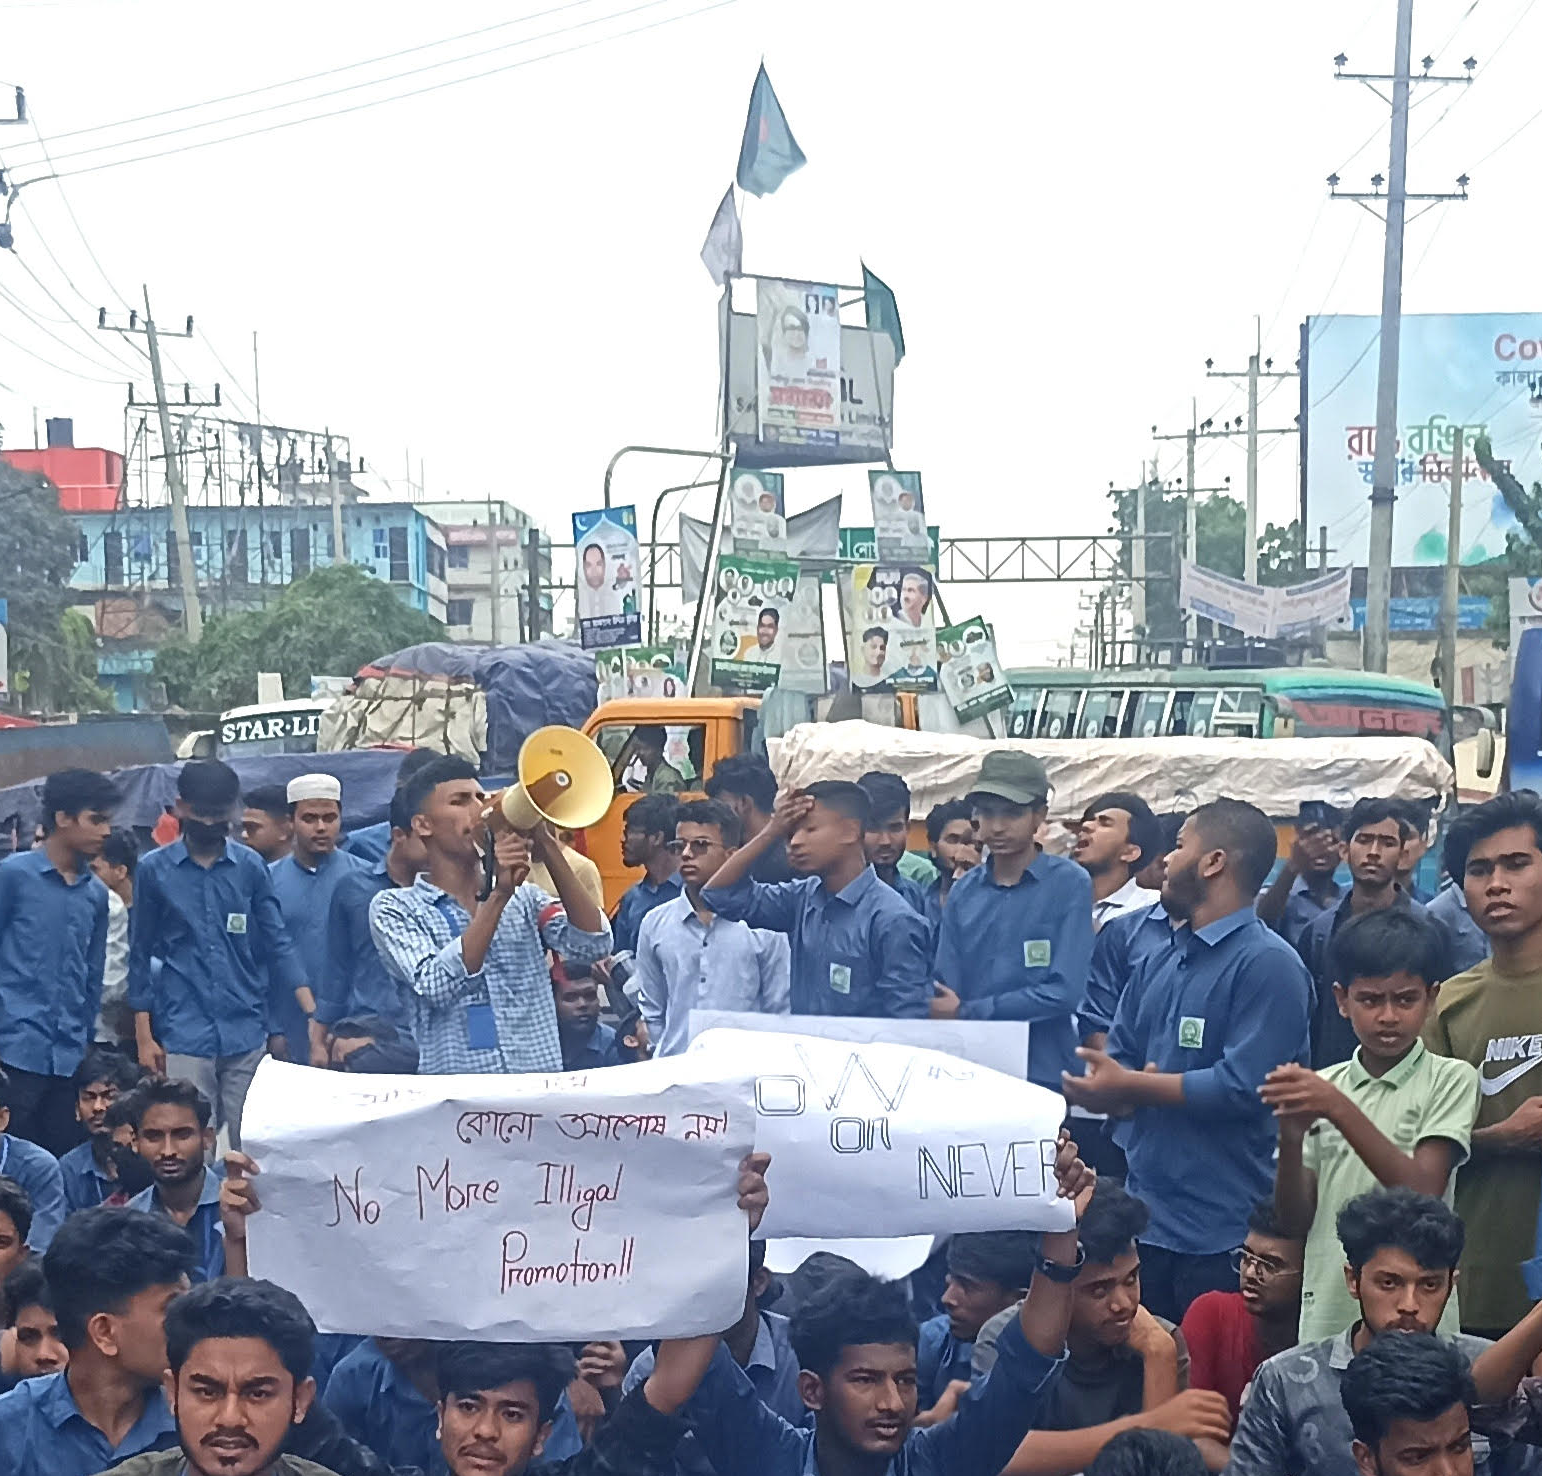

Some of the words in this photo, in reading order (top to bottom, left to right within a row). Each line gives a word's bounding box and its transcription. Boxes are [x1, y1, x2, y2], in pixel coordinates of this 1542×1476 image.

[456, 1110, 543, 1145] কোনো
[326, 1165, 381, 1227] No
[417, 1157, 500, 1221] More
[918, 1138, 1060, 1199] NEVER
